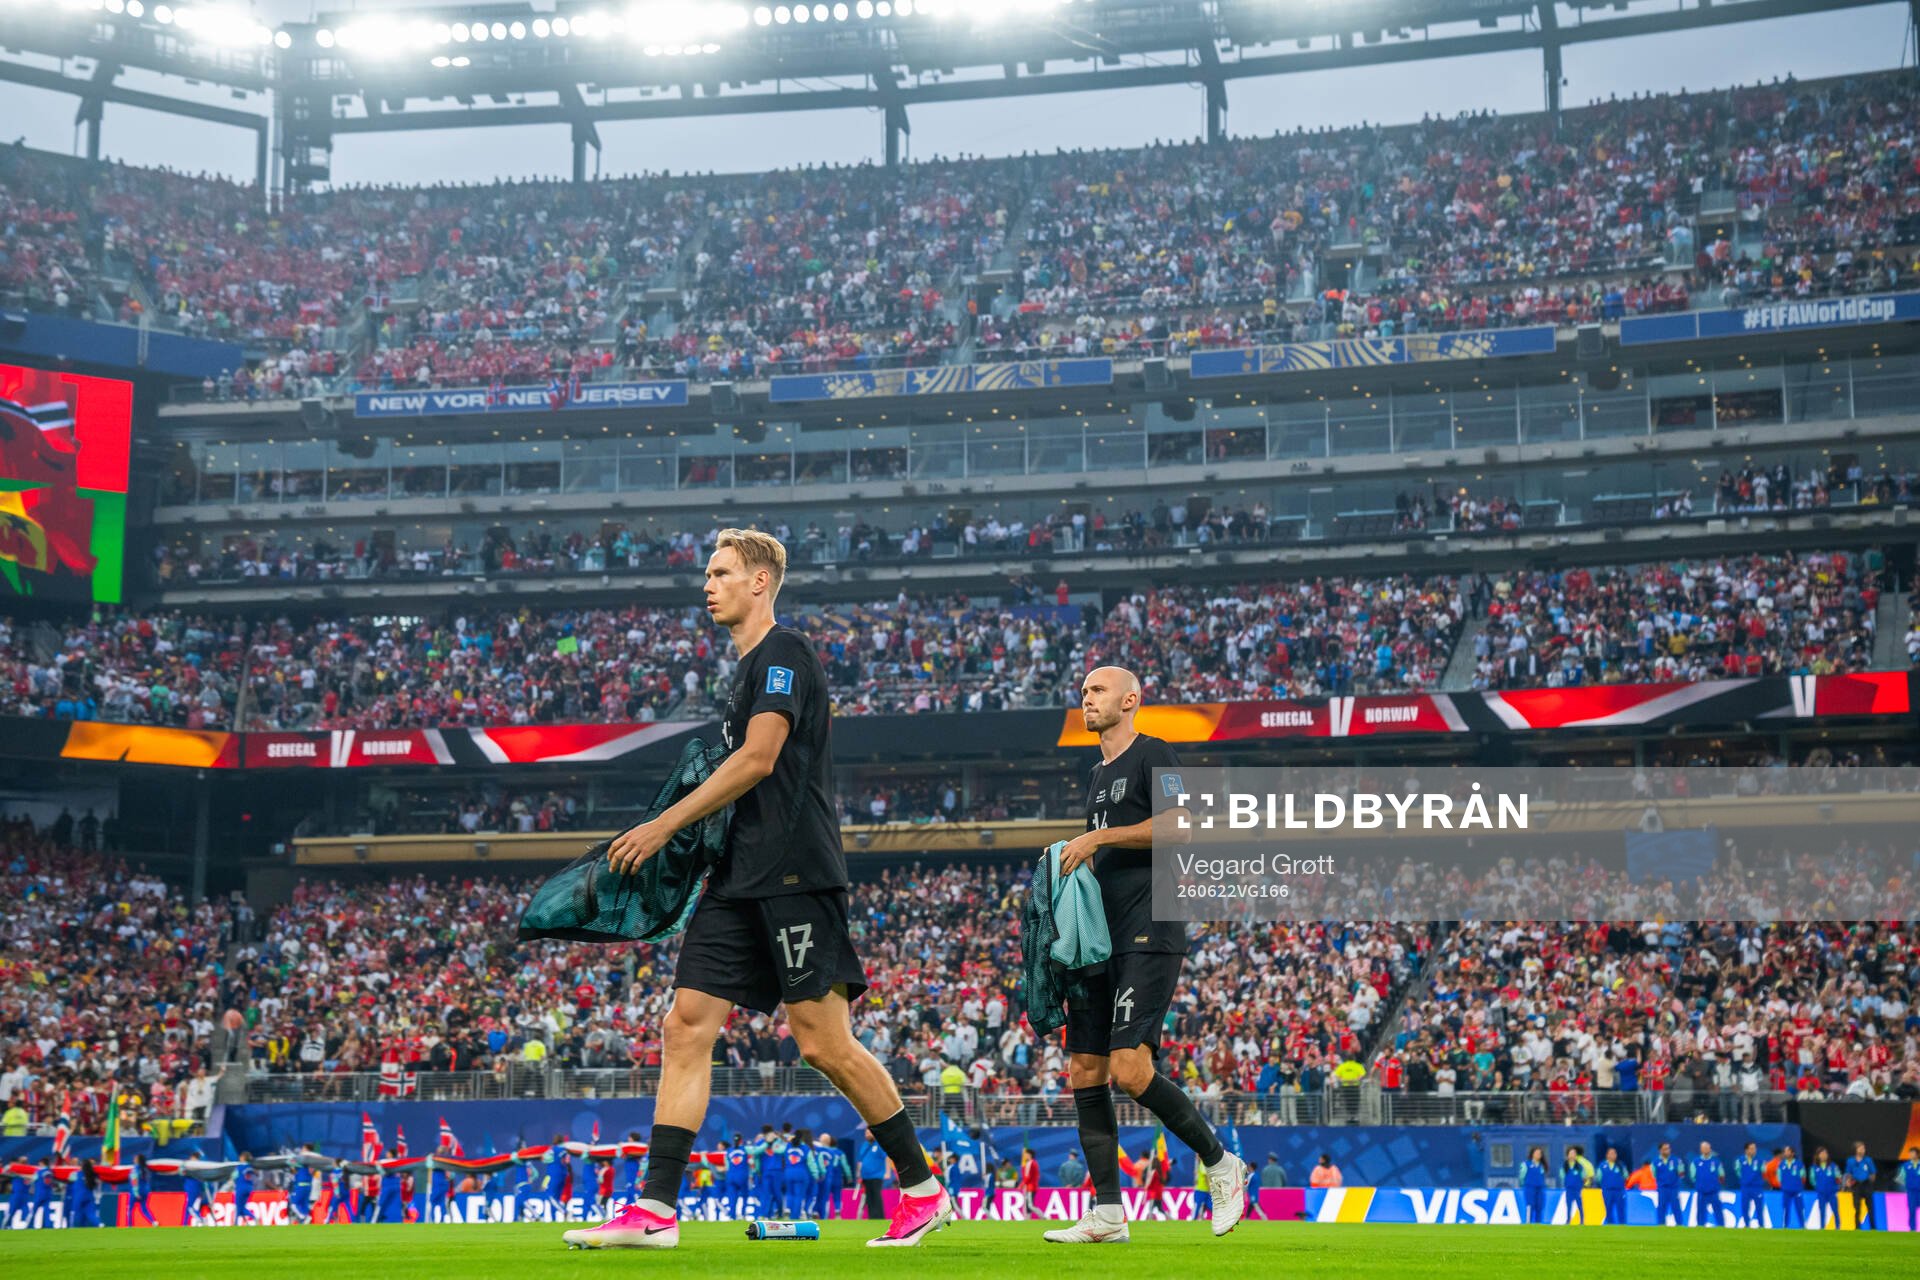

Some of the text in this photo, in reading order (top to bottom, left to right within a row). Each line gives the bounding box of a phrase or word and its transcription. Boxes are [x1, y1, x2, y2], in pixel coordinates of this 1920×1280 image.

[1744, 298, 1895, 330] #FIFAWorldCup
[369, 396, 426, 411] NEW
[1261, 710, 1314, 728] SENEGAL
[1365, 706, 1419, 723] NORWAY
[267, 743, 318, 758] SENEGAL
[362, 740, 412, 755] NORWAY
[776, 922, 814, 968] 17
[1399, 1188, 1522, 1224] VISA
